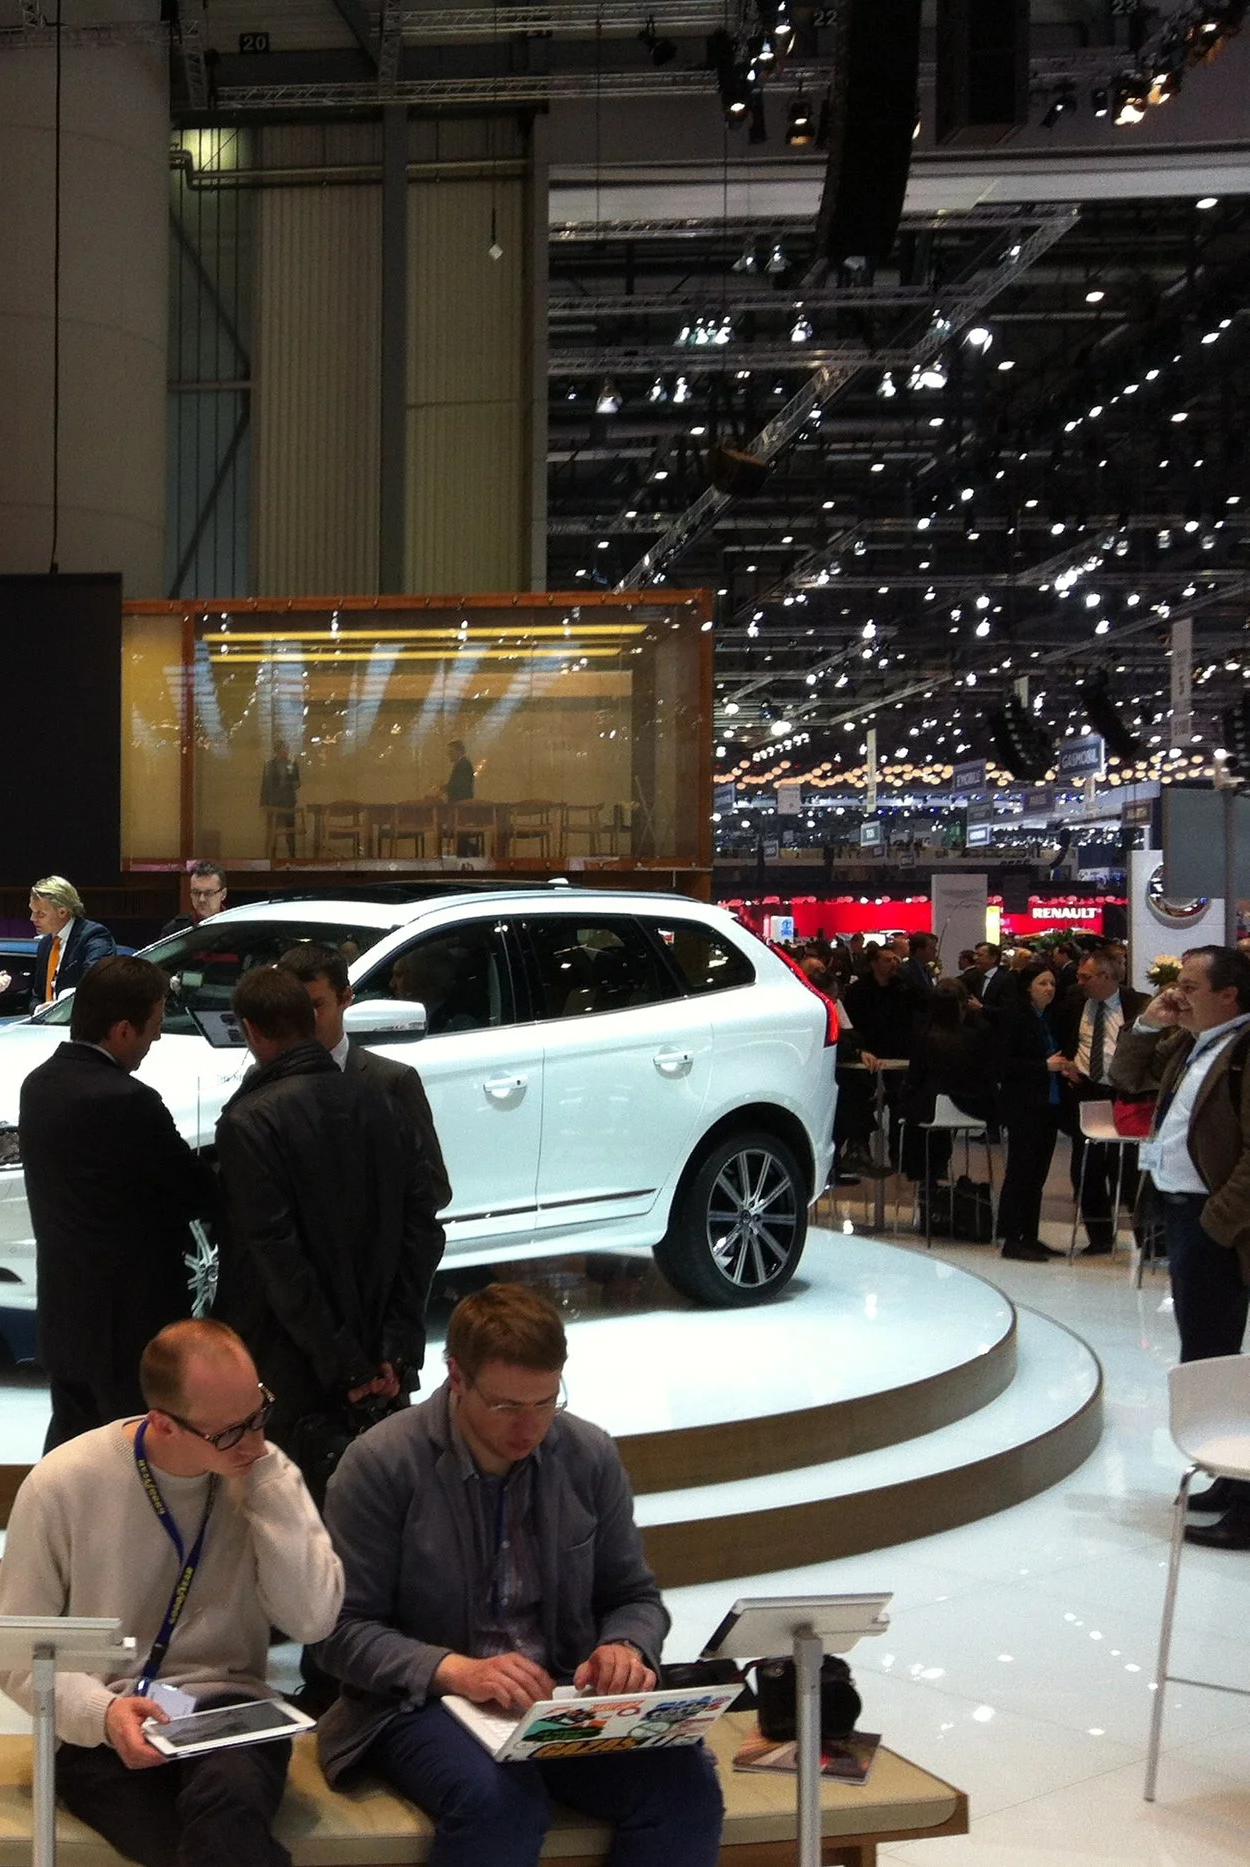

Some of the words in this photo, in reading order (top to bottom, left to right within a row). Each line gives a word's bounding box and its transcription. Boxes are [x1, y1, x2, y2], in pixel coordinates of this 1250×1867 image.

[813, 9, 838, 26] 22
[243, 35, 267, 51] 20
[1033, 907, 1096, 919] RENAULT
